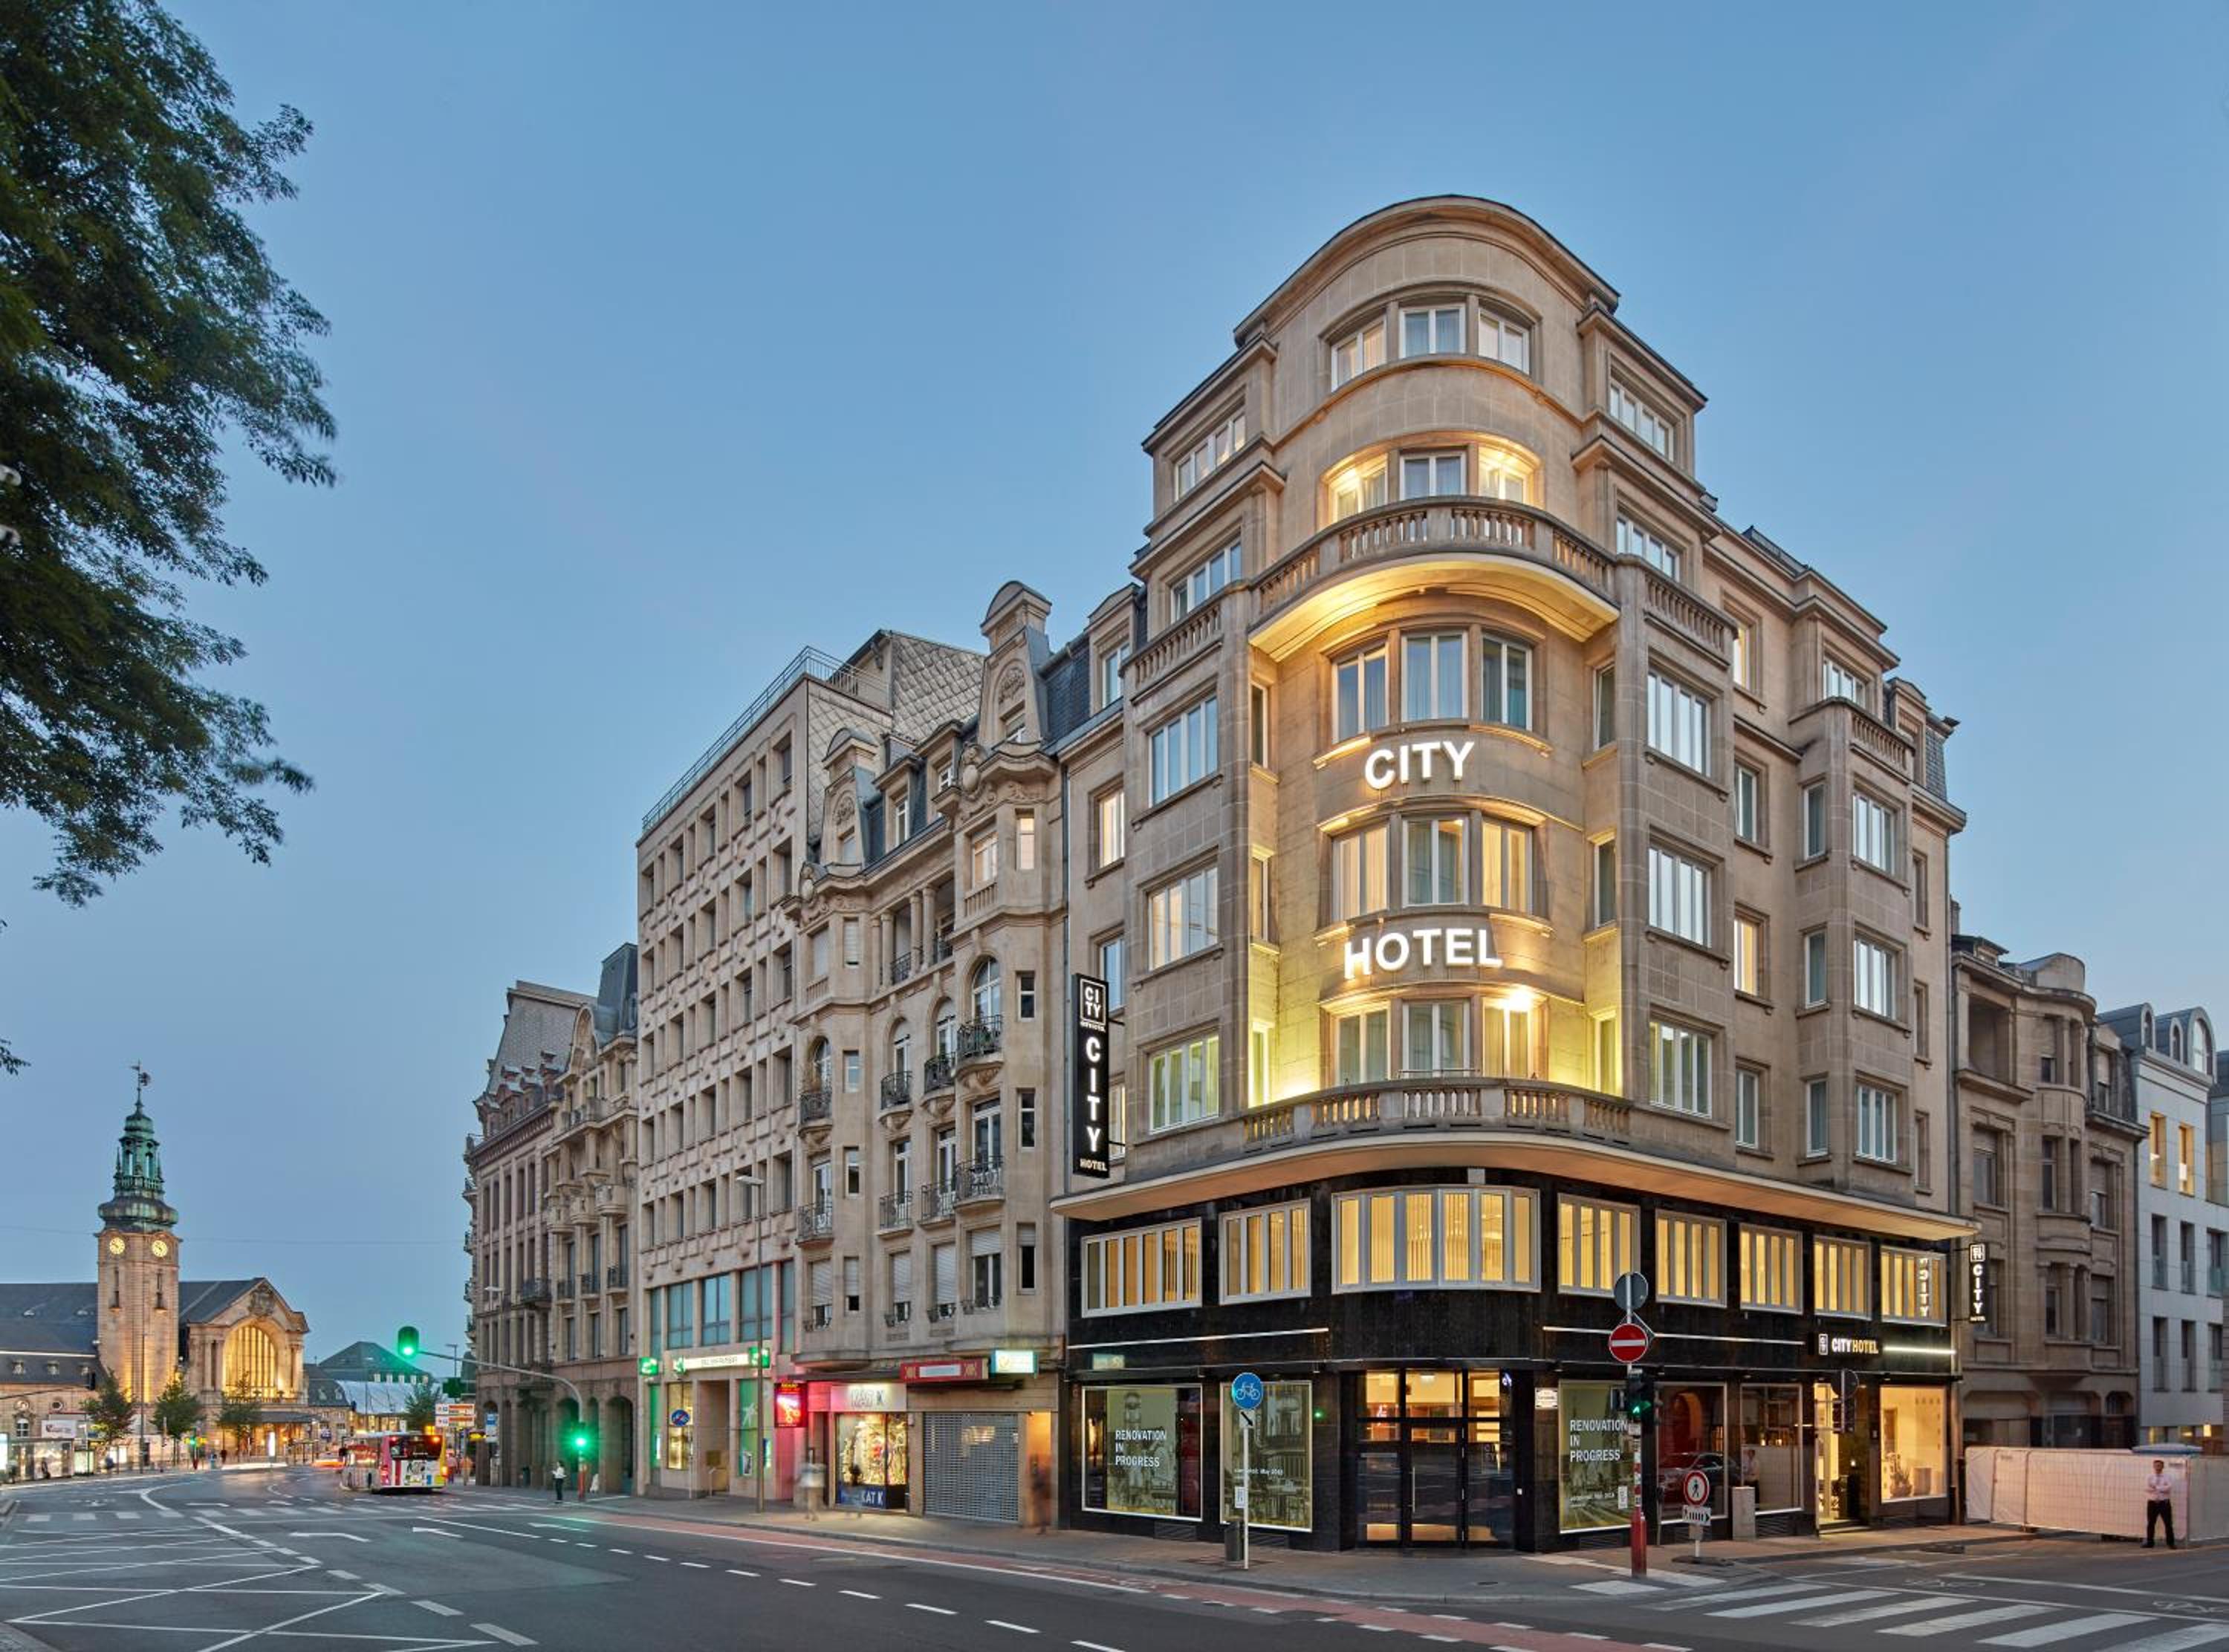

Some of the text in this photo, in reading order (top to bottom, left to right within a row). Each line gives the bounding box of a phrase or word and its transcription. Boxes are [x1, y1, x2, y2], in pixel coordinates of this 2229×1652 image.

[1365, 741, 1474, 790] CITY
[1344, 928, 1502, 980] HOTEL
[1086, 1037, 1100, 1152] CITY
[1080, 1158, 1107, 1171] HOTEL
[1973, 1264, 1983, 1314] CITY
[1570, 1418, 1628, 1432] RENOVATION
[1115, 1429, 1167, 1440] RENOVATION
[1570, 1434, 1580, 1447] IN
[1115, 1442, 1124, 1452] IN
[1115, 1455, 1160, 1467] PROGRESS
[1570, 1449, 1620, 1463] PROGRESS
